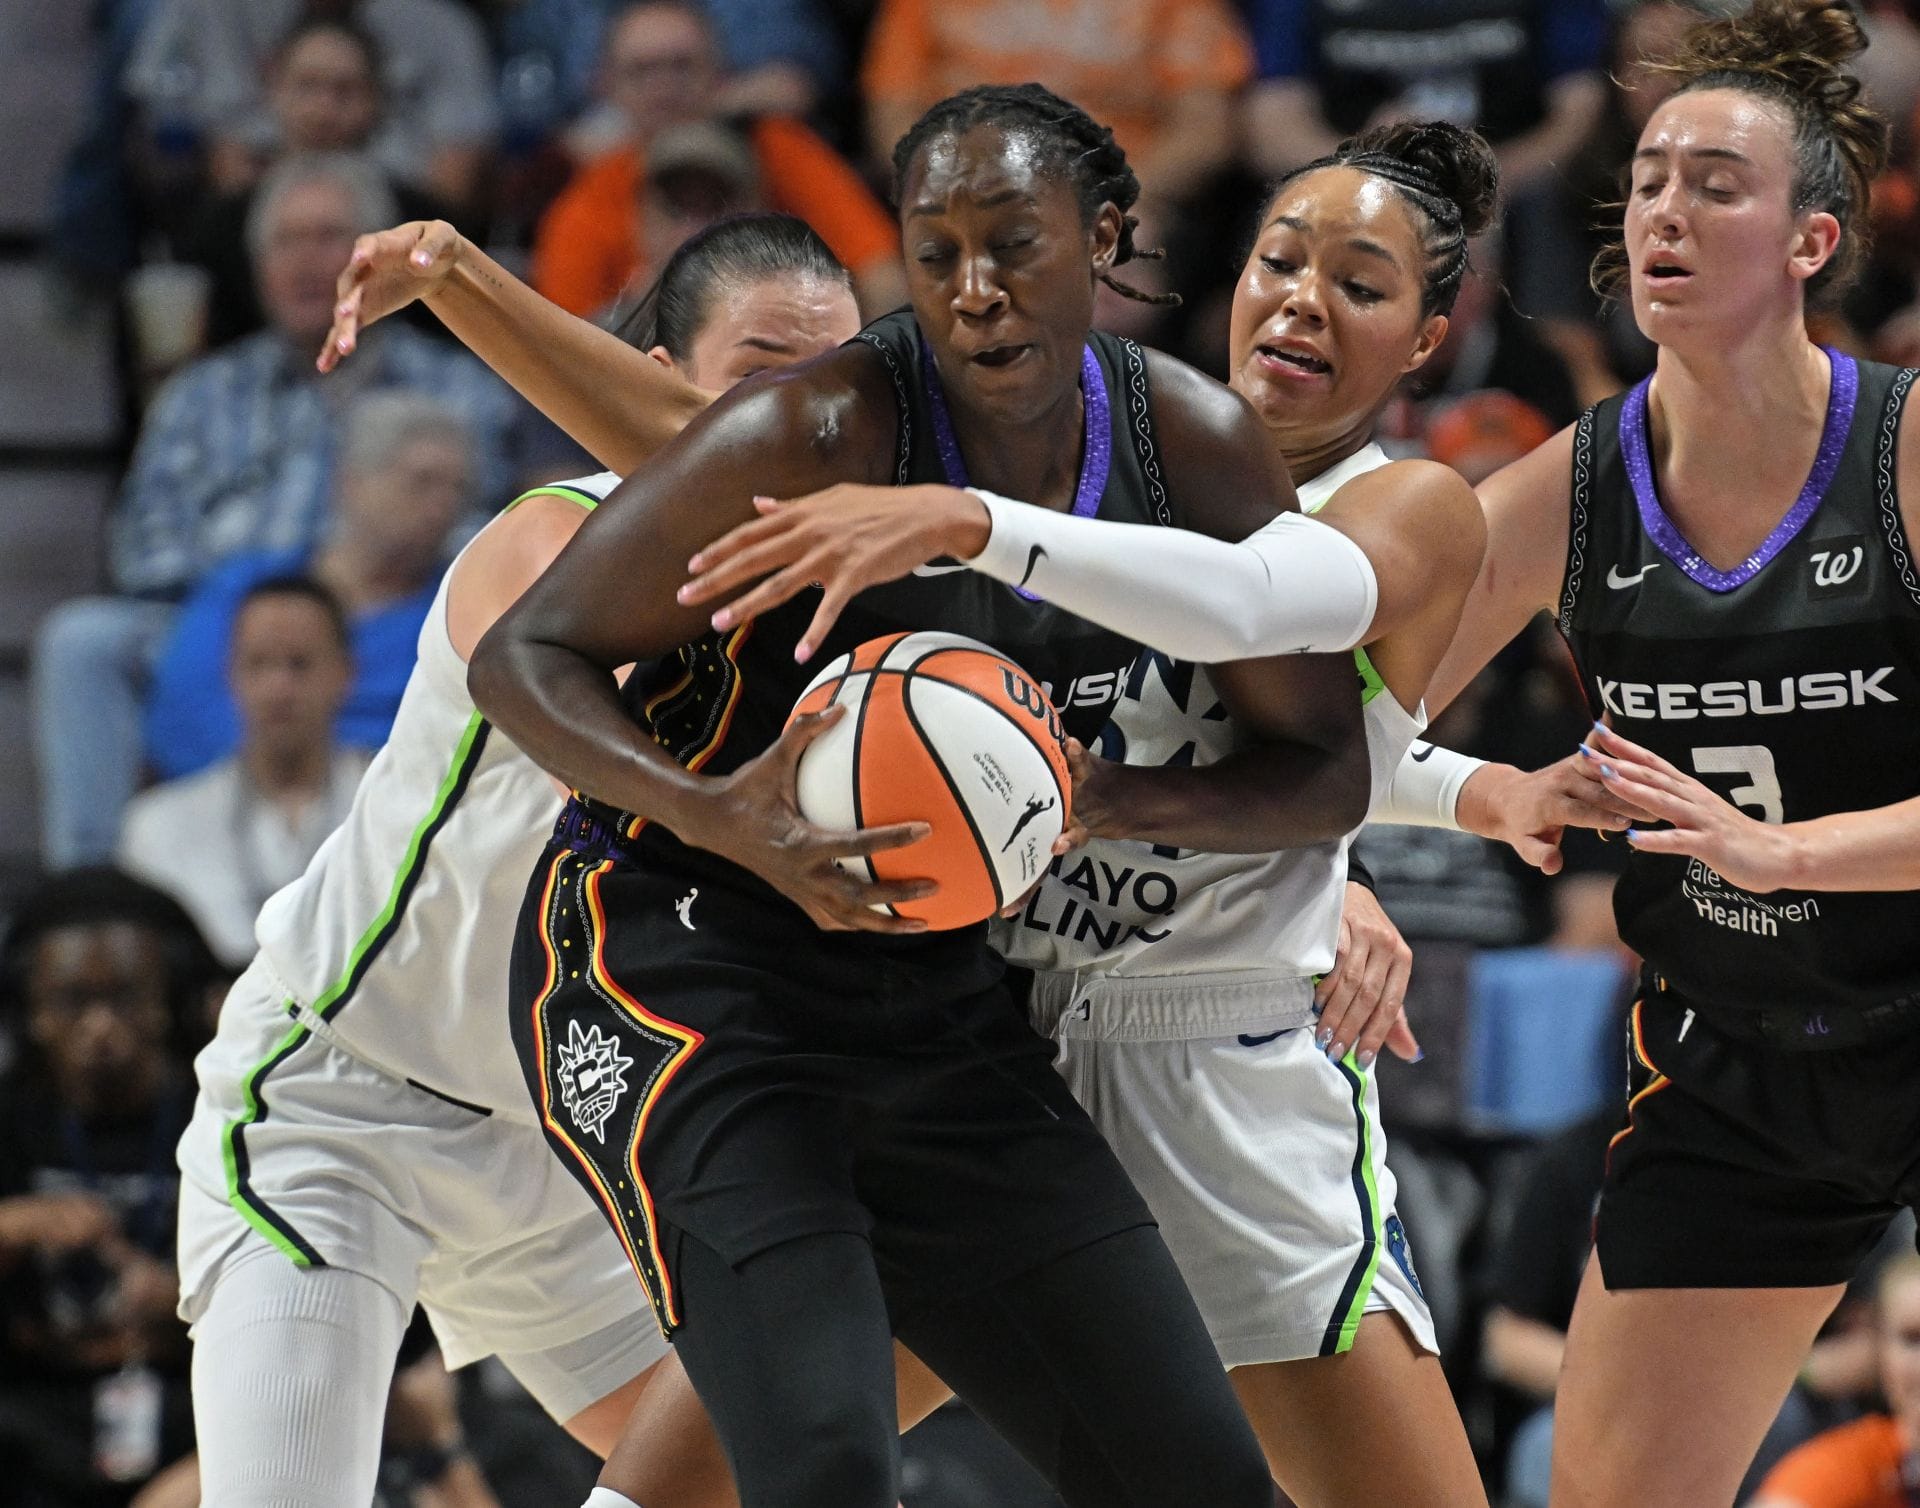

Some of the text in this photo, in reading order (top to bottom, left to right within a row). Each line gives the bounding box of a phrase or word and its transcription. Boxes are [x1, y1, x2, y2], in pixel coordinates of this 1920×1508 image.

[1596, 666, 1899, 719] KEESUSK
[973, 753, 996, 781] GAME
[994, 780, 1010, 806] BALL
[984, 753, 1013, 794] OFFICIAL
[1691, 745, 1784, 824] 3
[1050, 855, 1177, 915] AYO
[1693, 898, 1778, 937] Health
